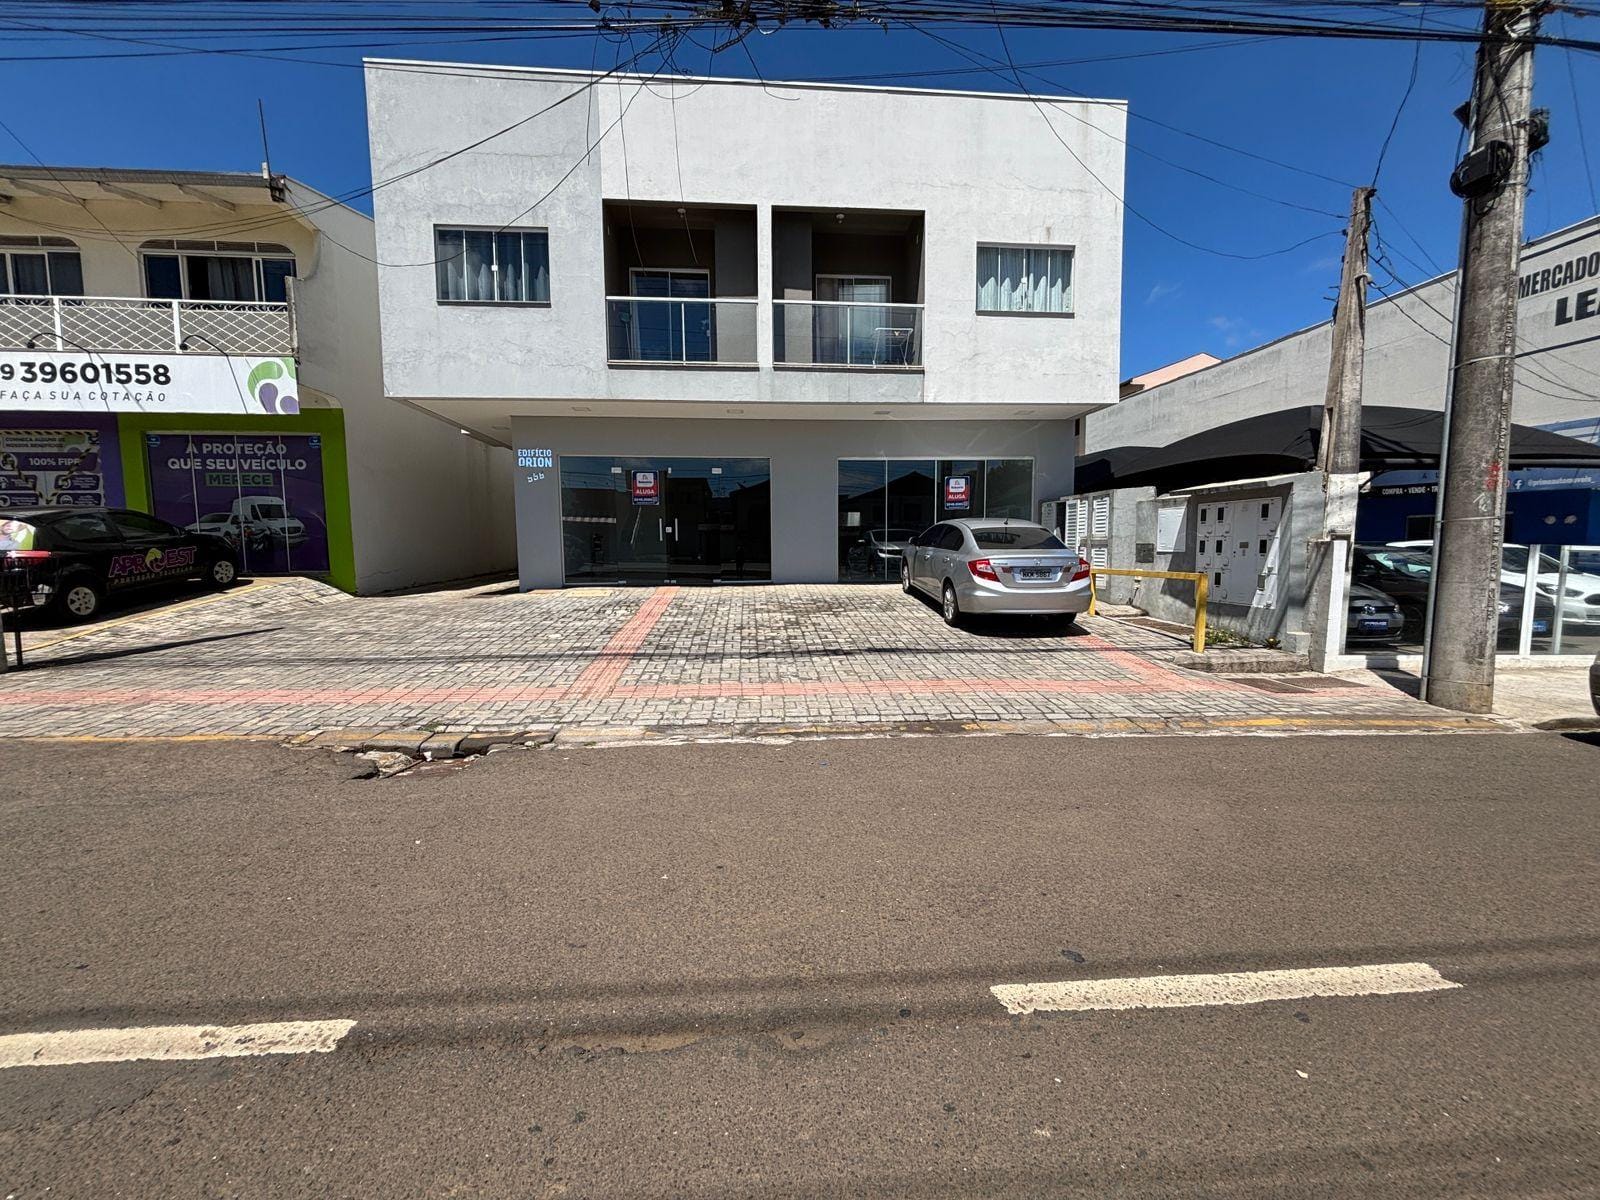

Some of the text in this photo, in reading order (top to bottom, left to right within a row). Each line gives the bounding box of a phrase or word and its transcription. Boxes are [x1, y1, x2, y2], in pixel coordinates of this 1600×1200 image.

[1518, 251, 1600, 299] MERCADO
[1555, 287, 1600, 326] LE
[20, 361, 171, 385] 39601558
[0, 390, 166, 403] FAÇA SUA COTAÇÃO
[186, 441, 287, 456] A PROTEÇÃO
[517, 448, 552, 457] EDIFÍCIO
[29, 458, 56, 466] 100%
[168, 456, 307, 470] QUE SEU VEÍCULO
[518, 457, 552, 467] ORION
[209, 474, 273, 486] MERECE
[1407, 486, 1426, 494] VENDE
